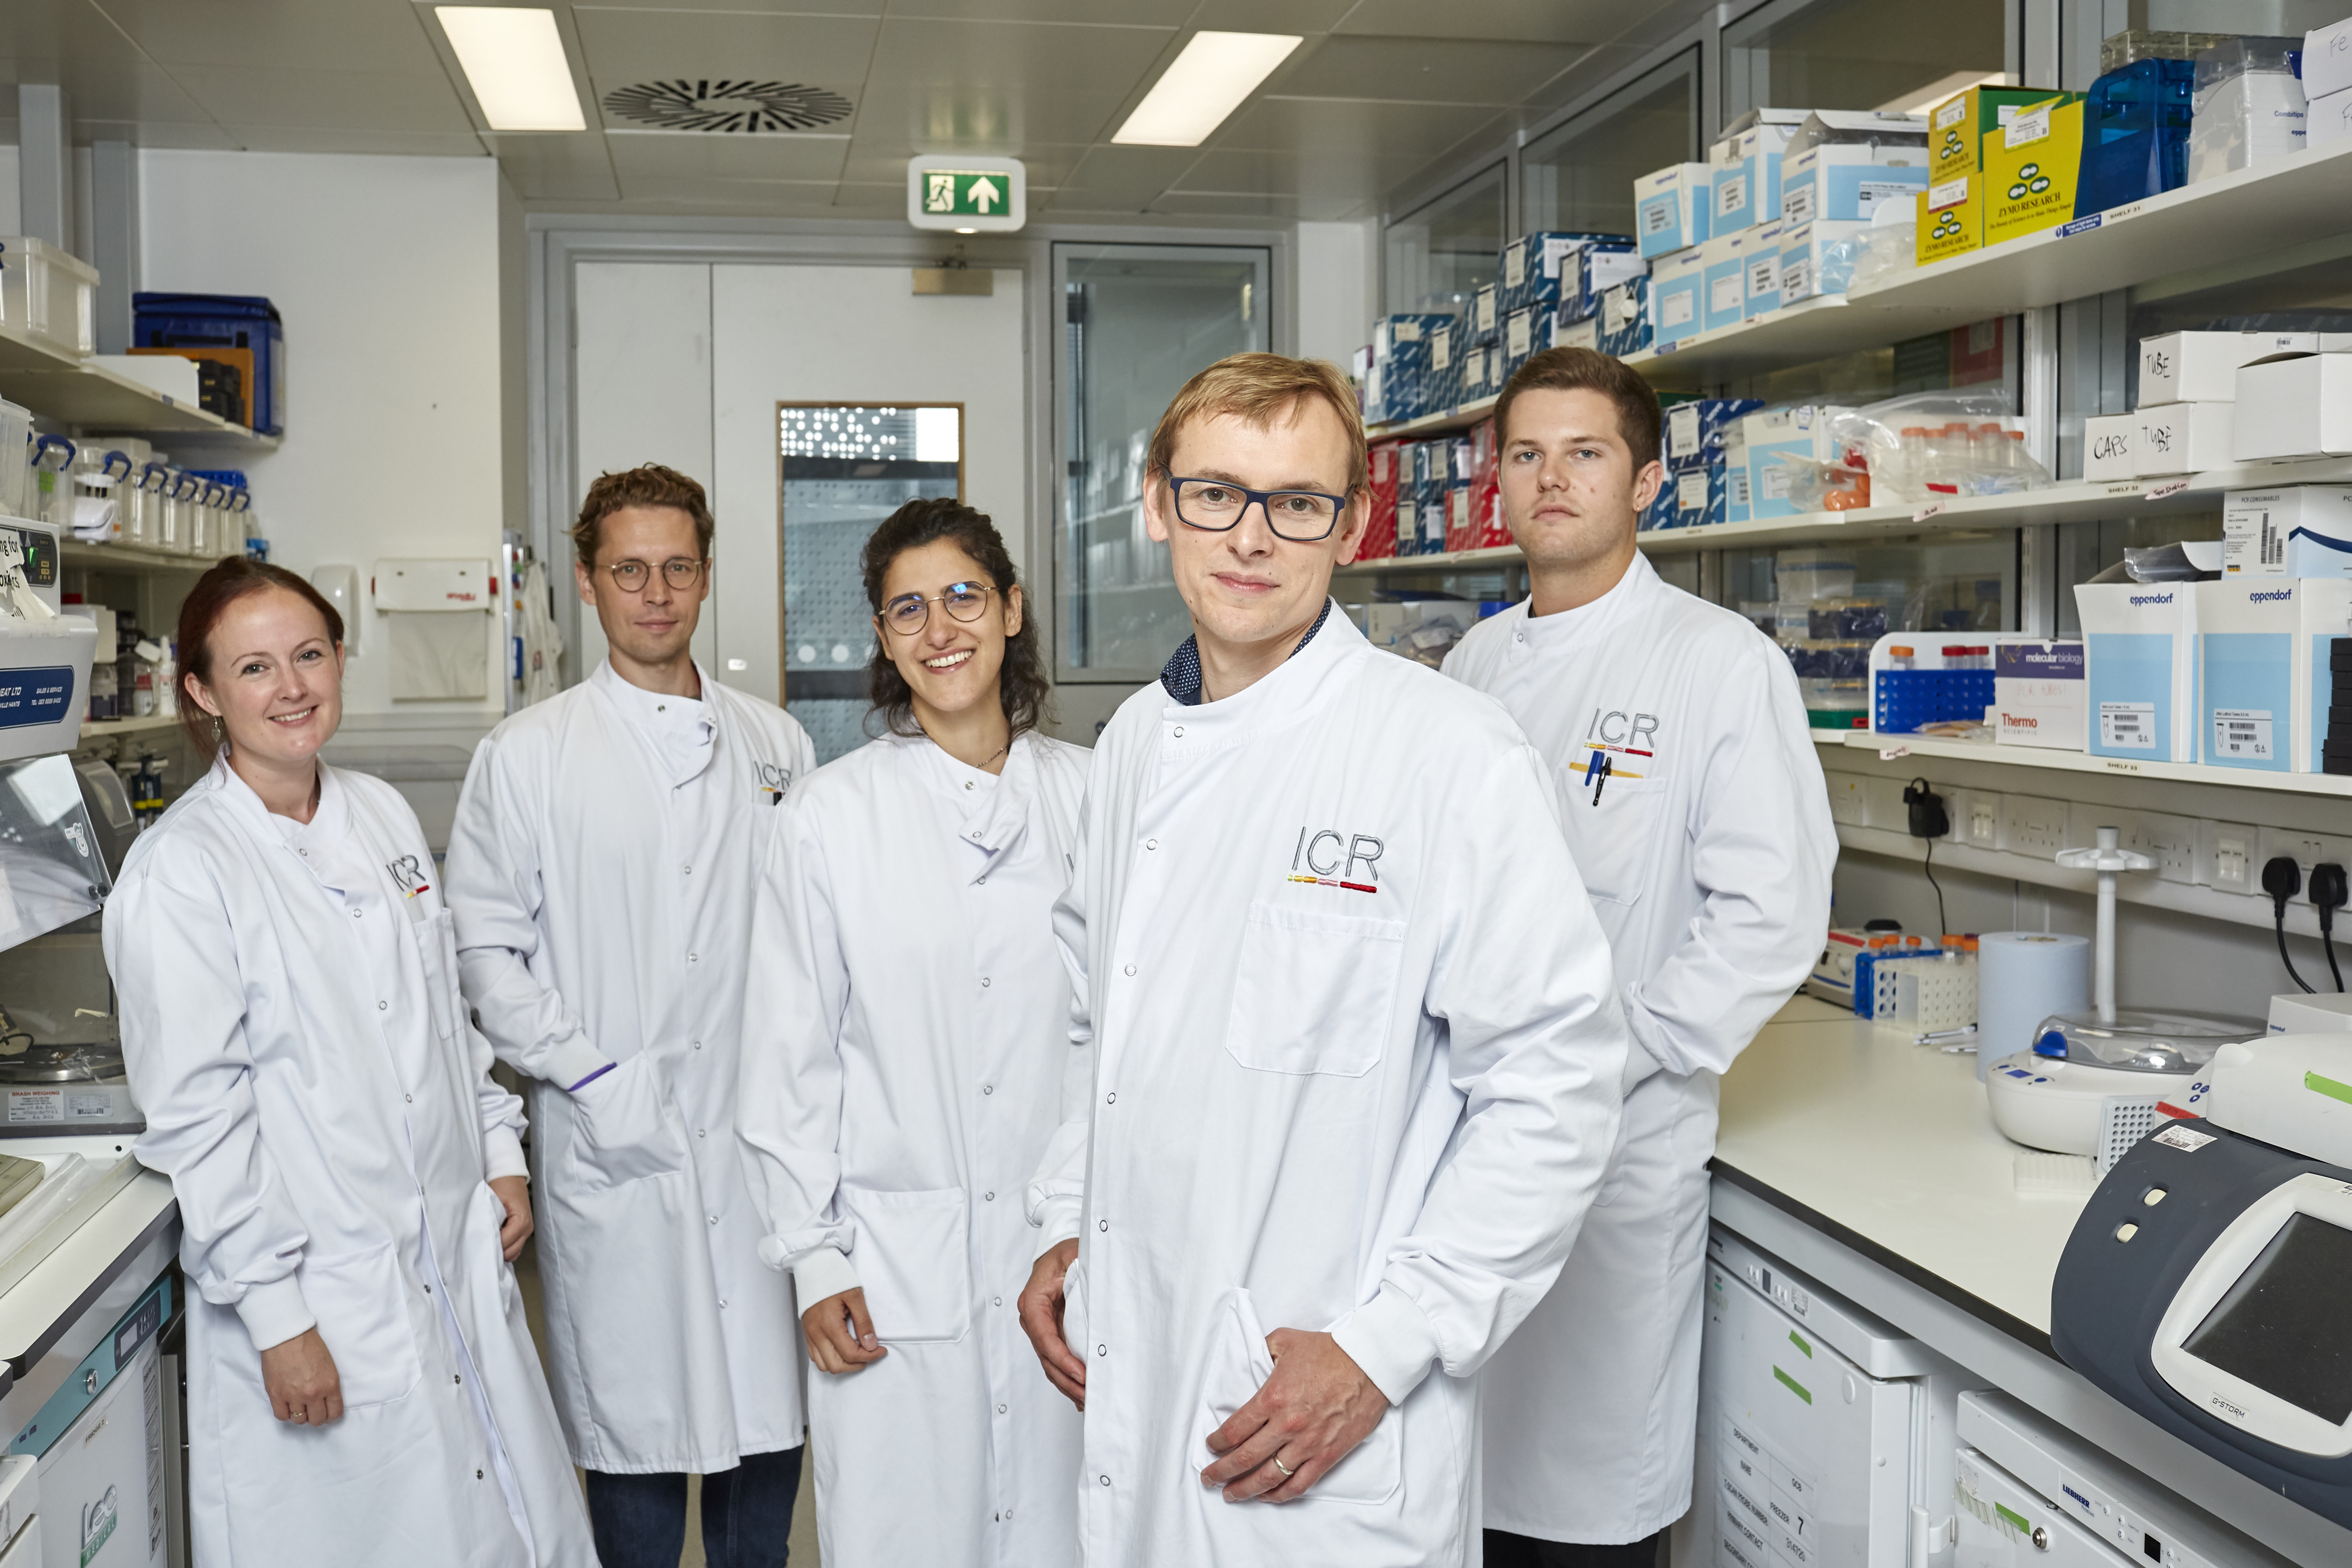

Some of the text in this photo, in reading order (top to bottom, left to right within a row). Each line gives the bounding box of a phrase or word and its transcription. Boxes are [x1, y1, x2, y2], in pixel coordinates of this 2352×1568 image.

[2274, 110, 2304, 118] Combitips
[2021, 192, 2060, 211] RESEARCH
[2110, 210, 2130, 219] SHELF
[2146, 351, 2170, 378] TUBE
[2094, 434, 2128, 460] CAPS
[2142, 425, 2172, 452] TUBE
[9, 535, 19, 553] for
[2130, 593, 2173, 607] eppendorf
[2250, 588, 2292, 604] eppendorf
[2026, 652, 2083, 665] molecular biology
[0, 687, 22, 697] EAT LTD
[1587, 708, 1659, 748] ICR
[2002, 713, 2038, 728] Thermo
[754, 761, 792, 790] ICR
[1292, 825, 1384, 881] ICR
[386, 854, 427, 892] ICR
[2212, 1397, 2245, 1419] G-STORM
[86, 1422, 102, 1443] FRIDGE
[2063, 1484, 2090, 1509] LIEBHERR
[1770, 1501, 1789, 1524] FREEZER
[1797, 1515, 1804, 1536] 7
[86, 1519, 116, 1560] MEDICAL
